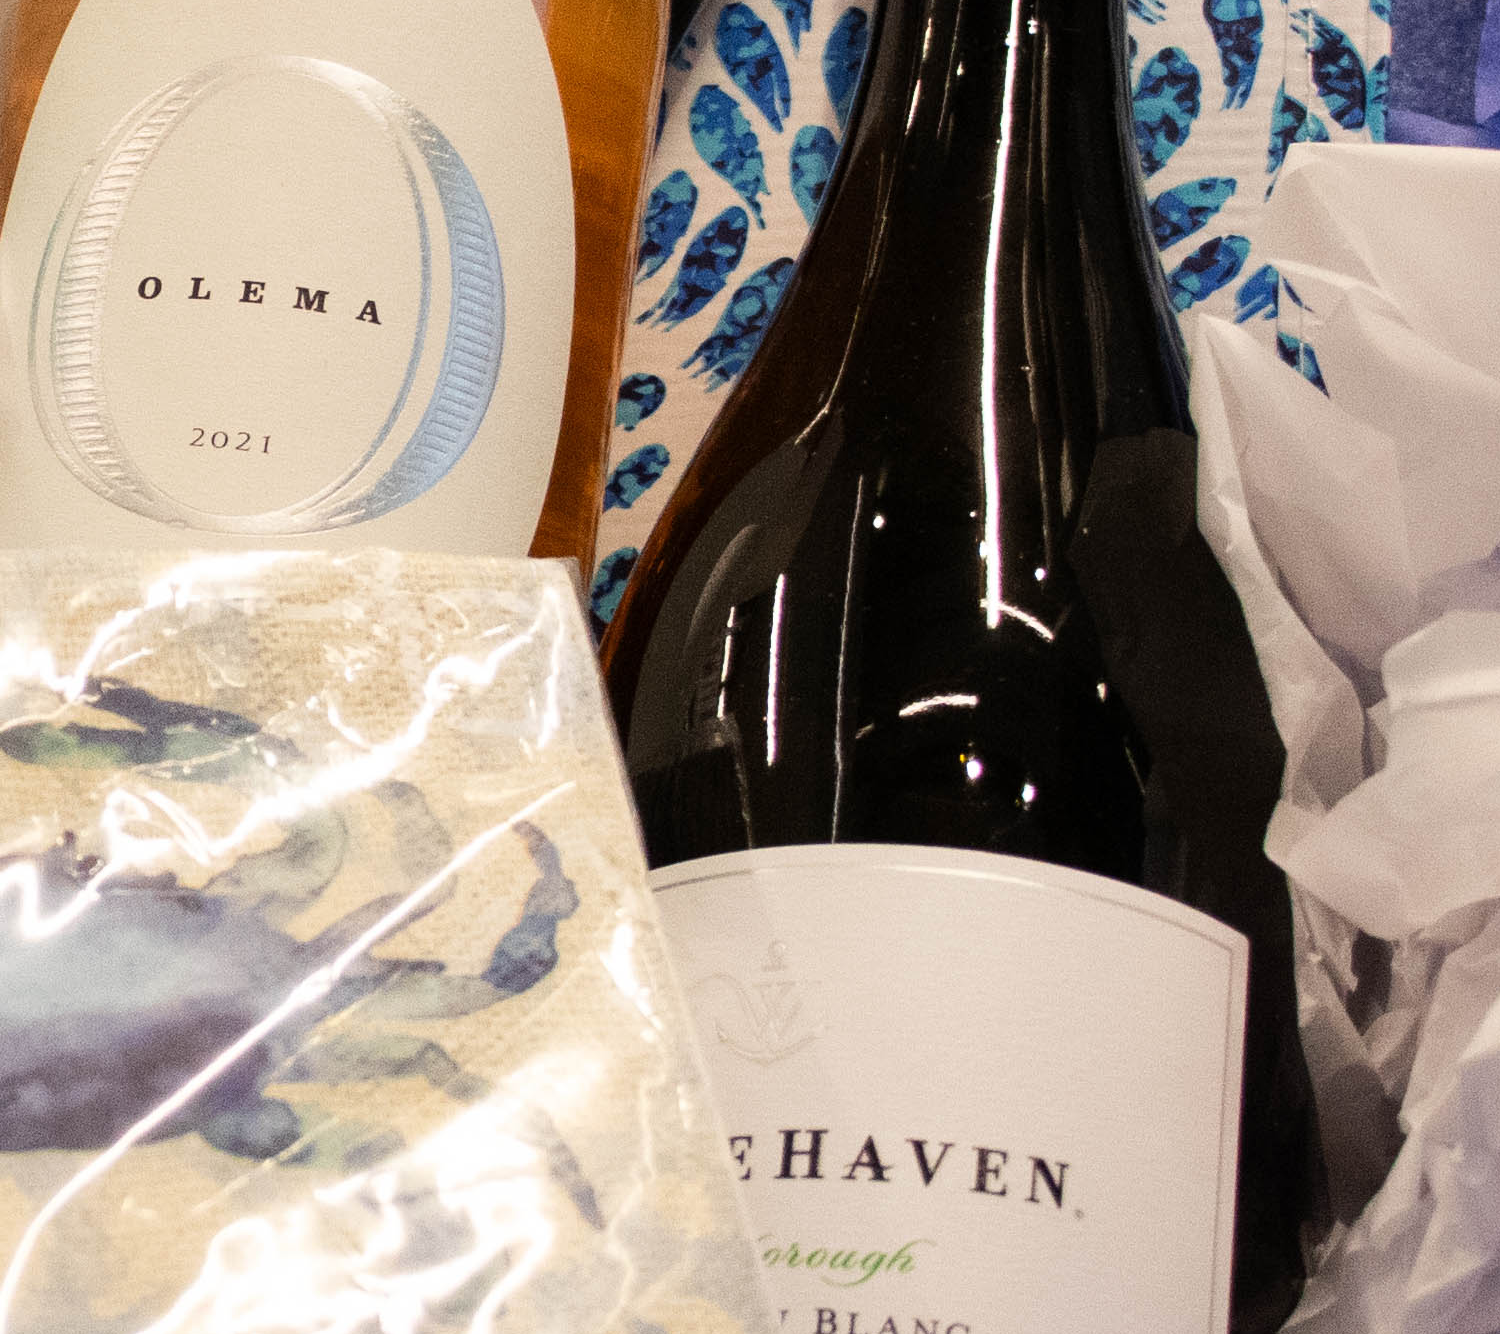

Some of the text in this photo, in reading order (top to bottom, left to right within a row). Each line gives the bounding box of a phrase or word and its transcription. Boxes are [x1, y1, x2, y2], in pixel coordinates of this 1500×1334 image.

[137, 276, 383, 326] OLEMA
[188, 427, 272, 454] 2021
[757, 1233, 938, 1289] orough
